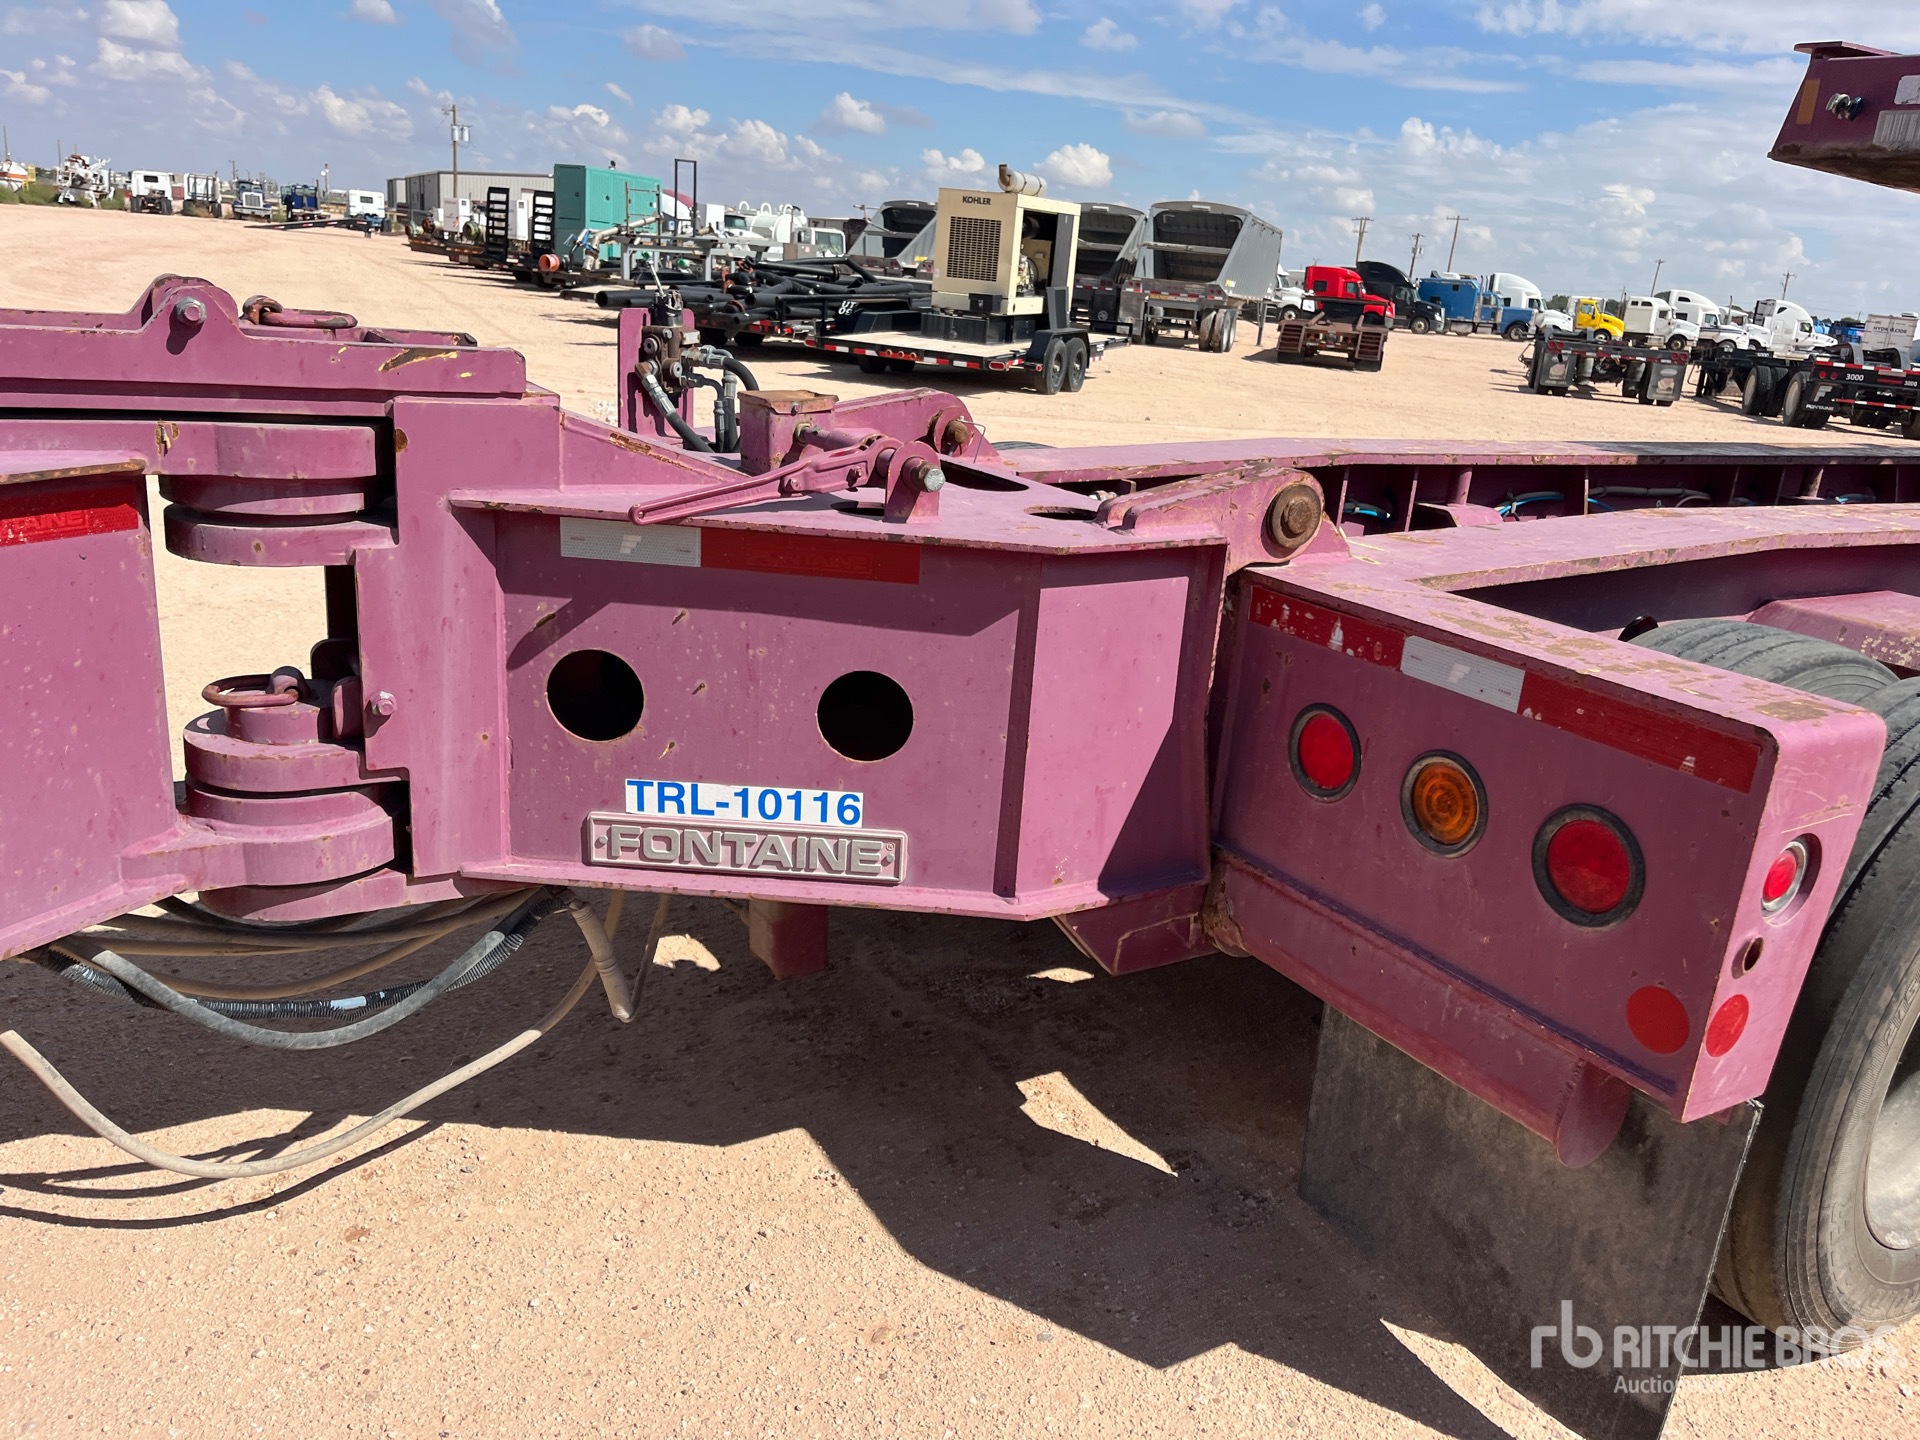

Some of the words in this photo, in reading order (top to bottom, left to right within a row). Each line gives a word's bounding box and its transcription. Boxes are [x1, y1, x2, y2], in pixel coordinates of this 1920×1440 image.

[962, 195, 992, 206] KOHLER
[1846, 373, 1864, 382] 3000
[627, 779, 862, 826] TRL-10116
[610, 824, 885, 875] FONTAINE
